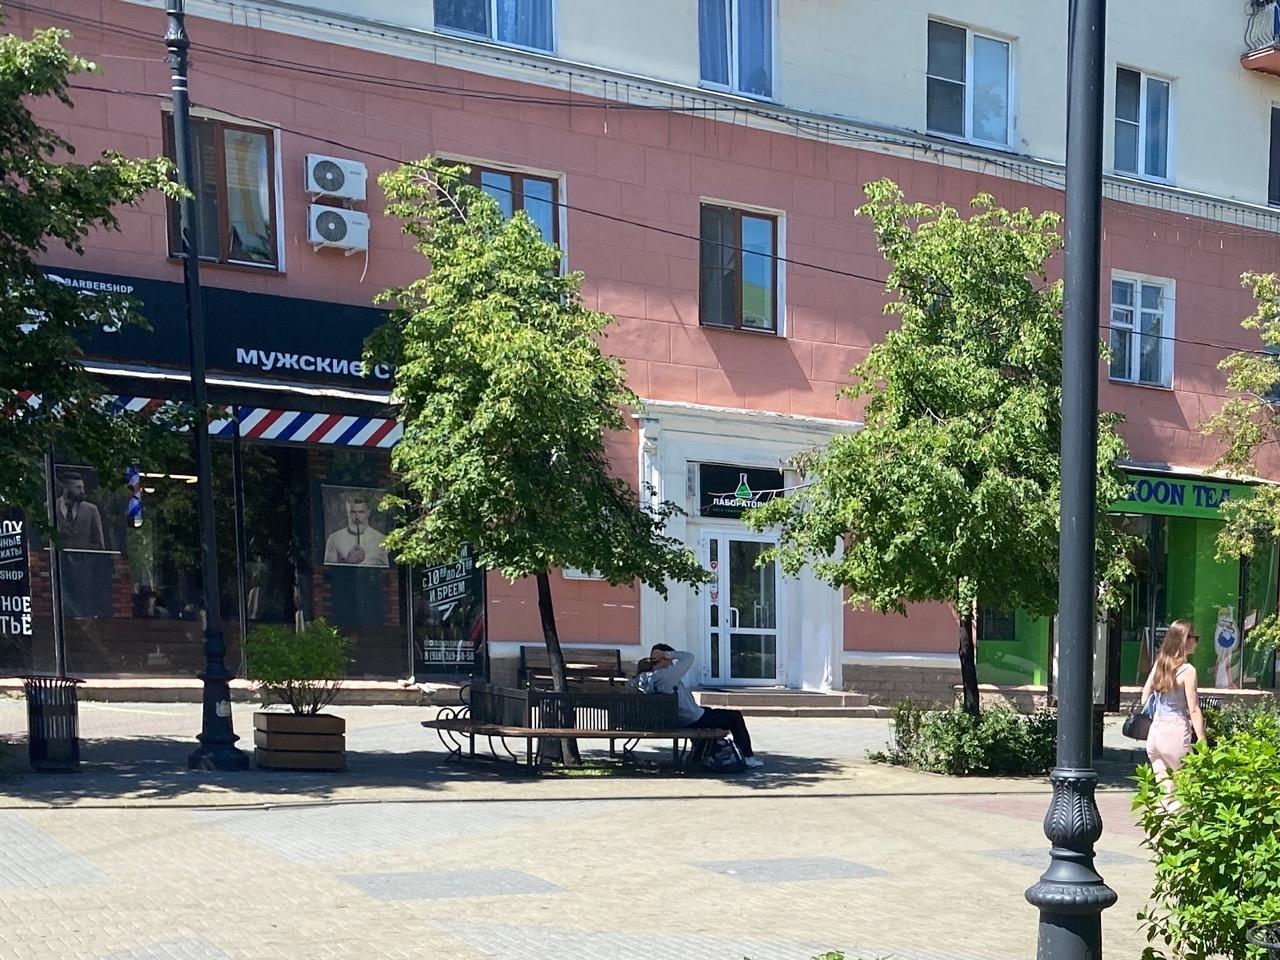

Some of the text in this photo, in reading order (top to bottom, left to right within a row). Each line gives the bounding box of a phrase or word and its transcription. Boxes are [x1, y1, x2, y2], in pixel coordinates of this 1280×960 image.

[64, 278, 134, 294] BARBERSHOP
[713, 498, 767, 508] ЛАБОРАТОР
[437, 580, 466, 600] БРЕЕМ
